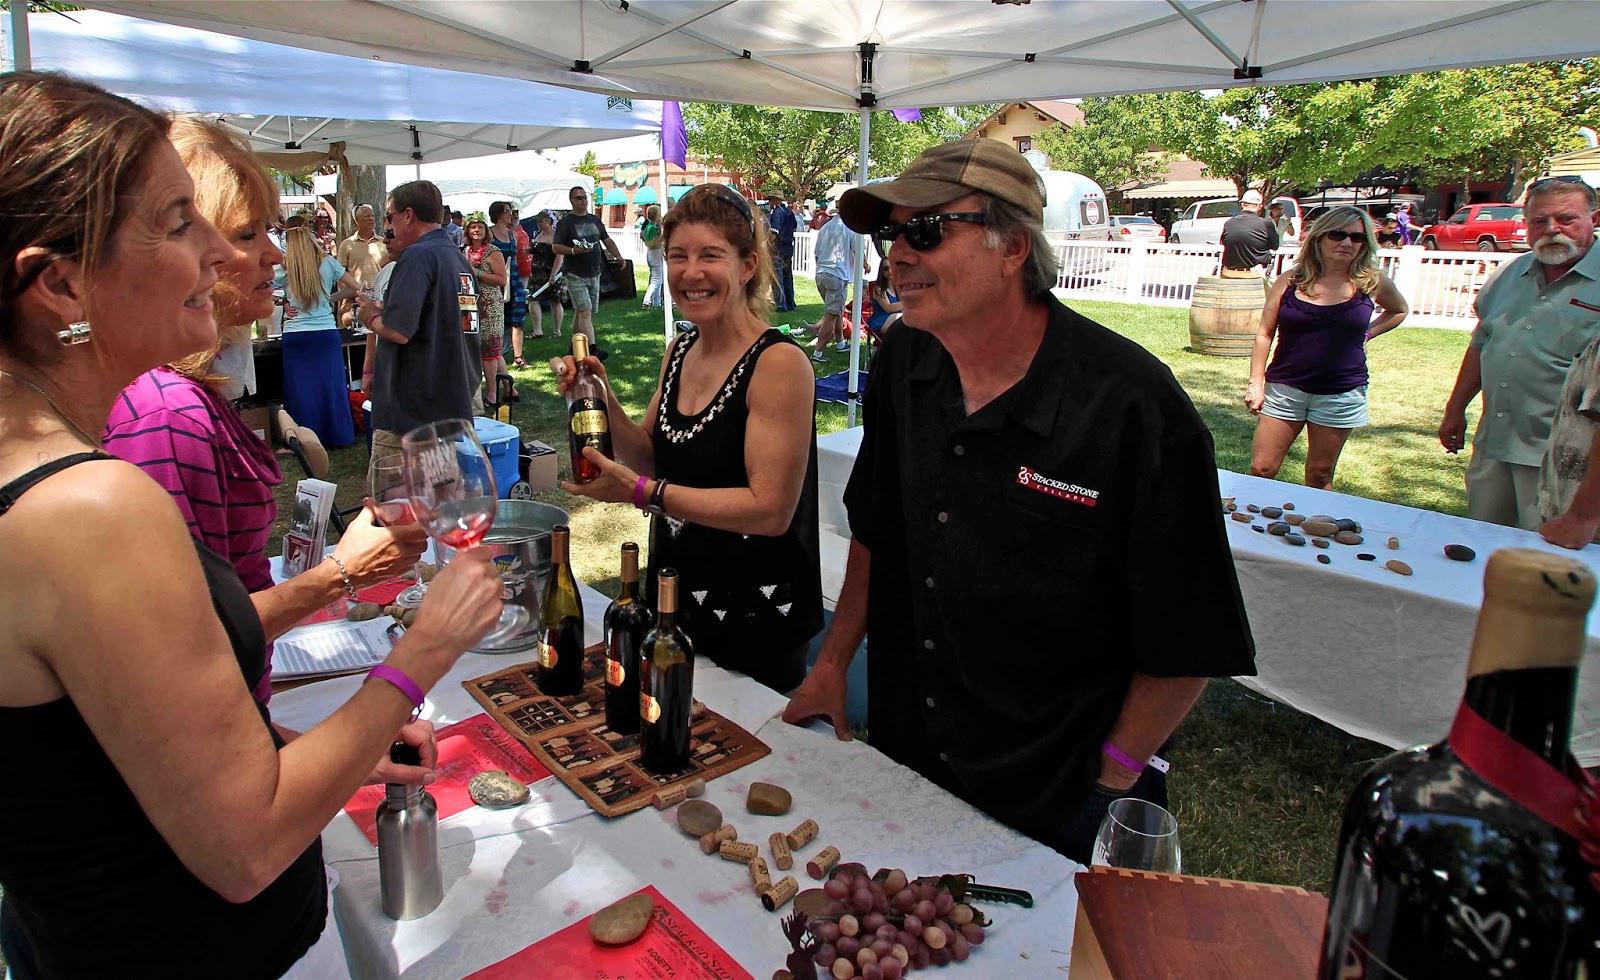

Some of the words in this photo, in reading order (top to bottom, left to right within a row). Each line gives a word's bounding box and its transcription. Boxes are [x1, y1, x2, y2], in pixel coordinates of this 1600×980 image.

[1031, 472, 1069, 491] STACKED
[1068, 484, 1100, 499] STONE
[665, 918, 709, 960] STACKED
[646, 947, 676, 978] ROSETTA
